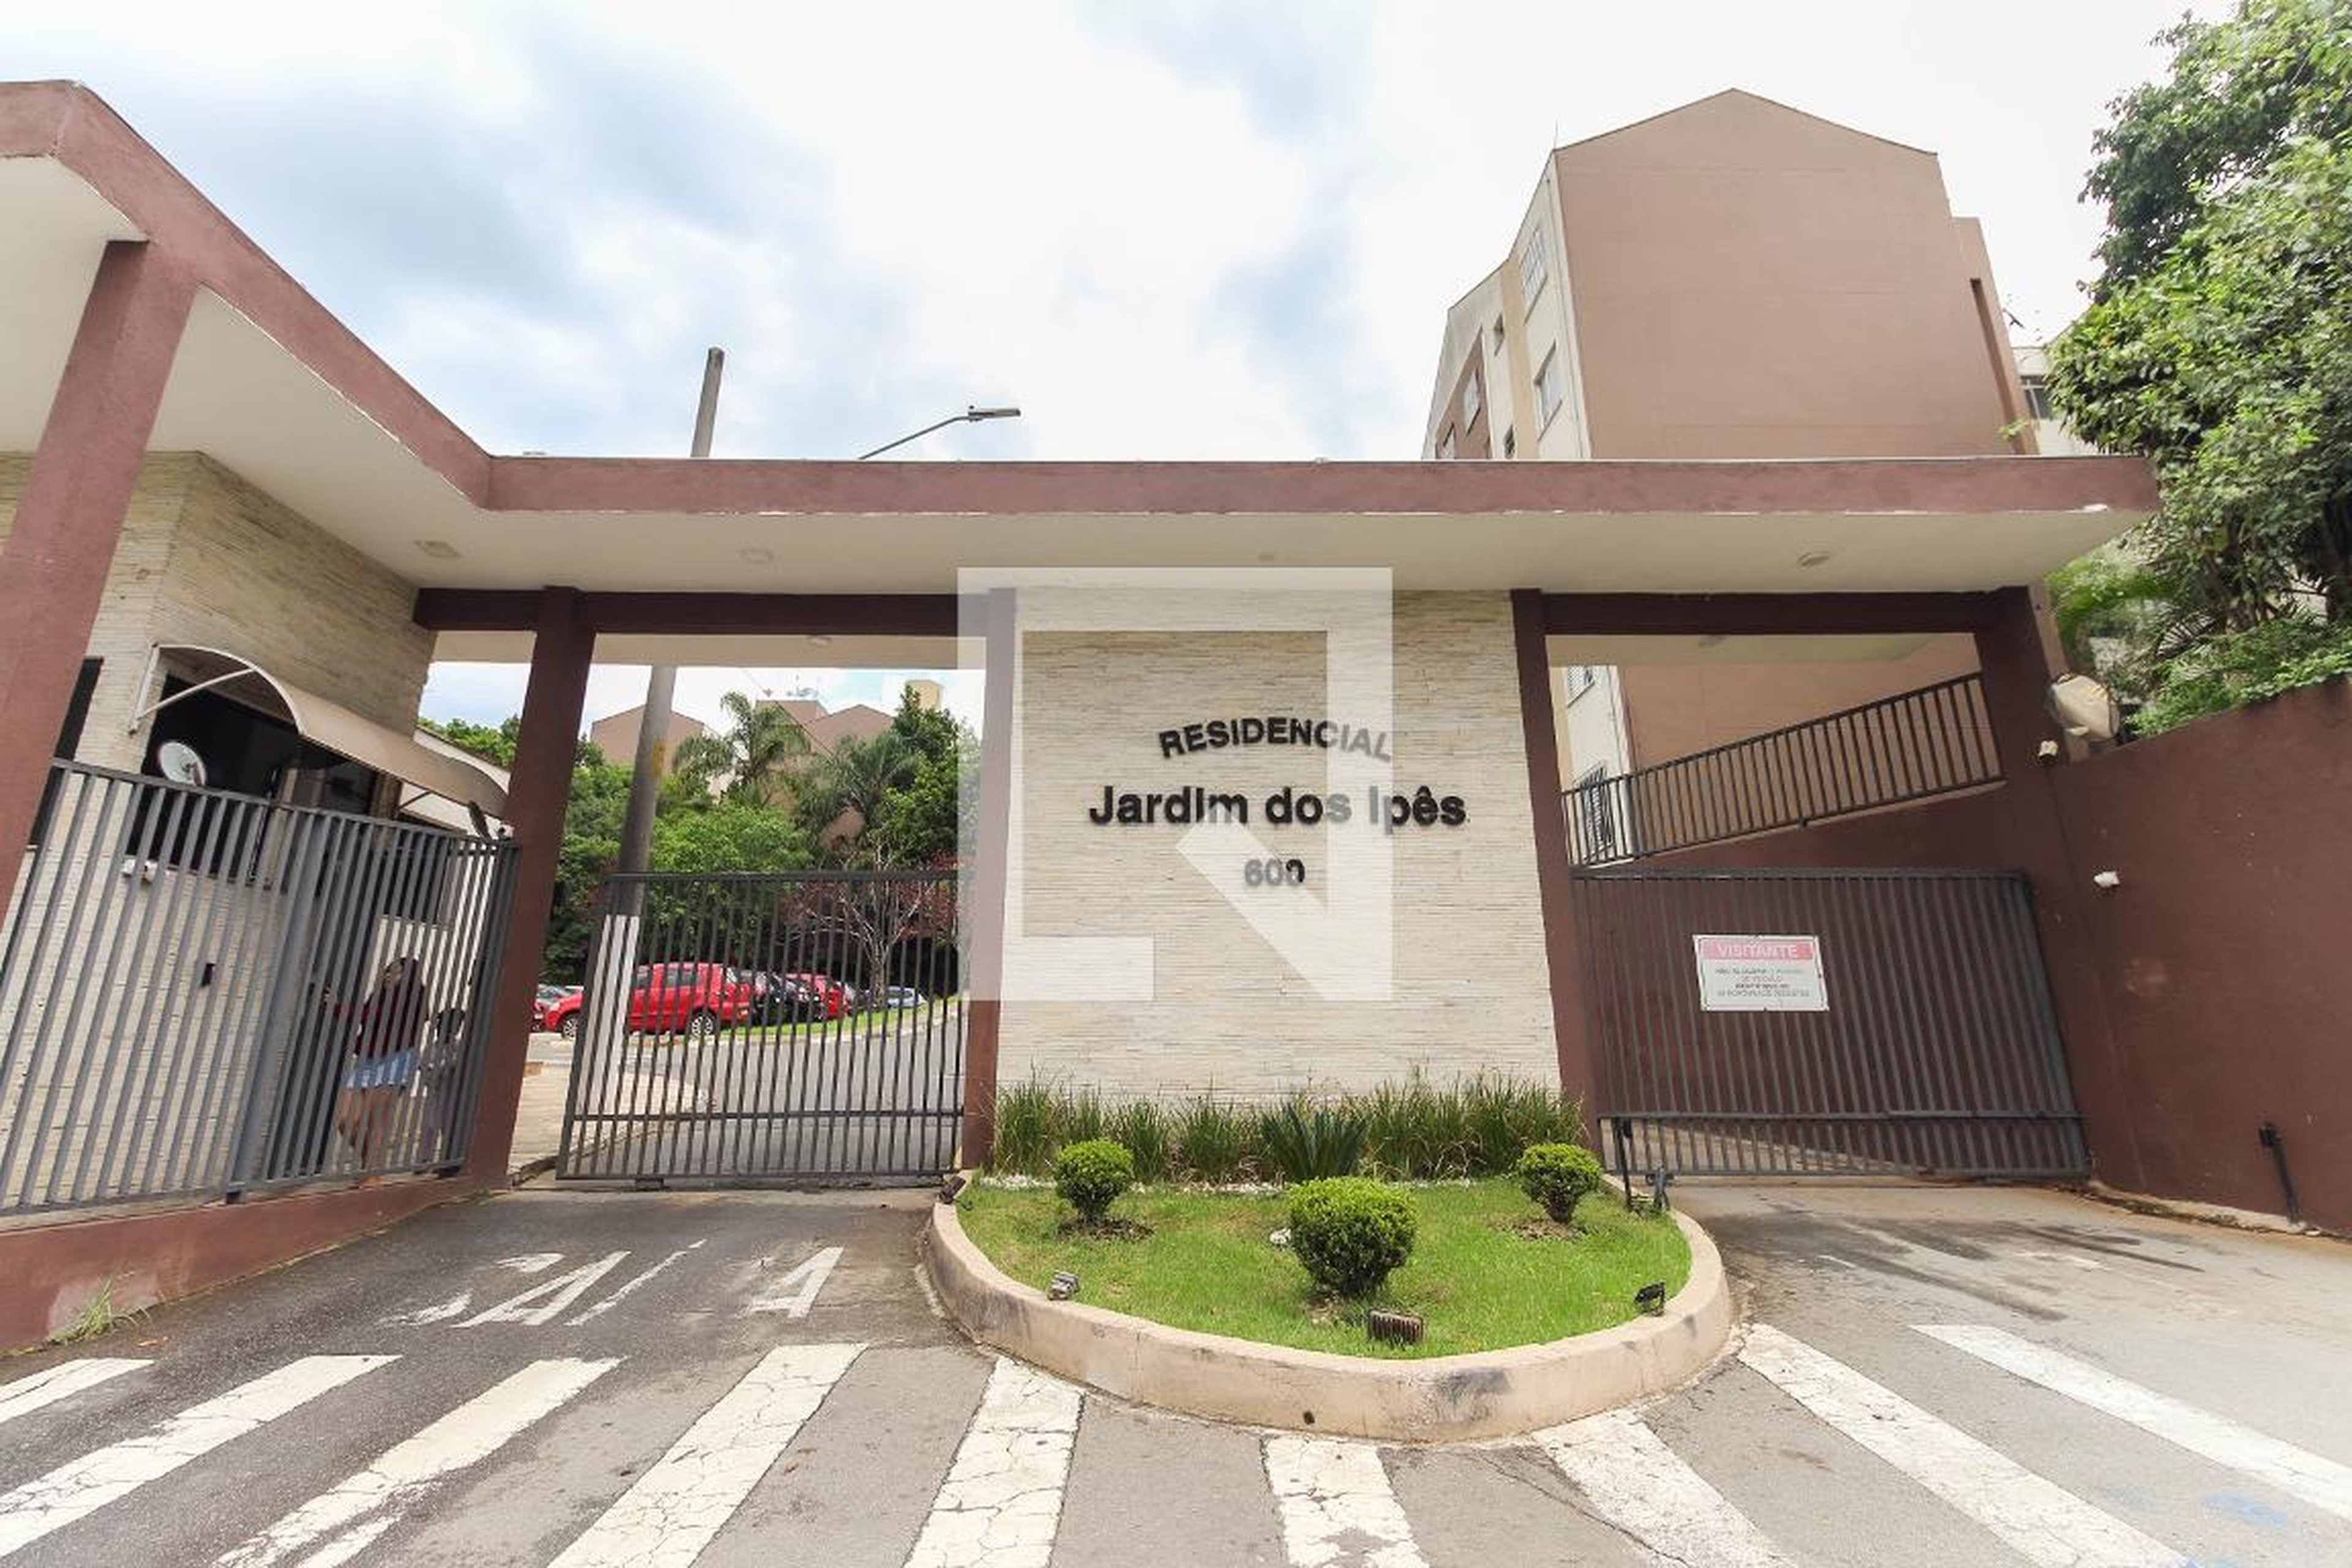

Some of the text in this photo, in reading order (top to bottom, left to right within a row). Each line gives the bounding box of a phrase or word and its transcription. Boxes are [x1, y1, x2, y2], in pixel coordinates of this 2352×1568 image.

[1159, 717, 1392, 761] RESIDENCIAL
[1265, 786, 1352, 825] dos
[1369, 785, 1468, 835] Ipês
[1244, 858, 1306, 887] 600
[1716, 943, 1798, 958] VISITANTE
